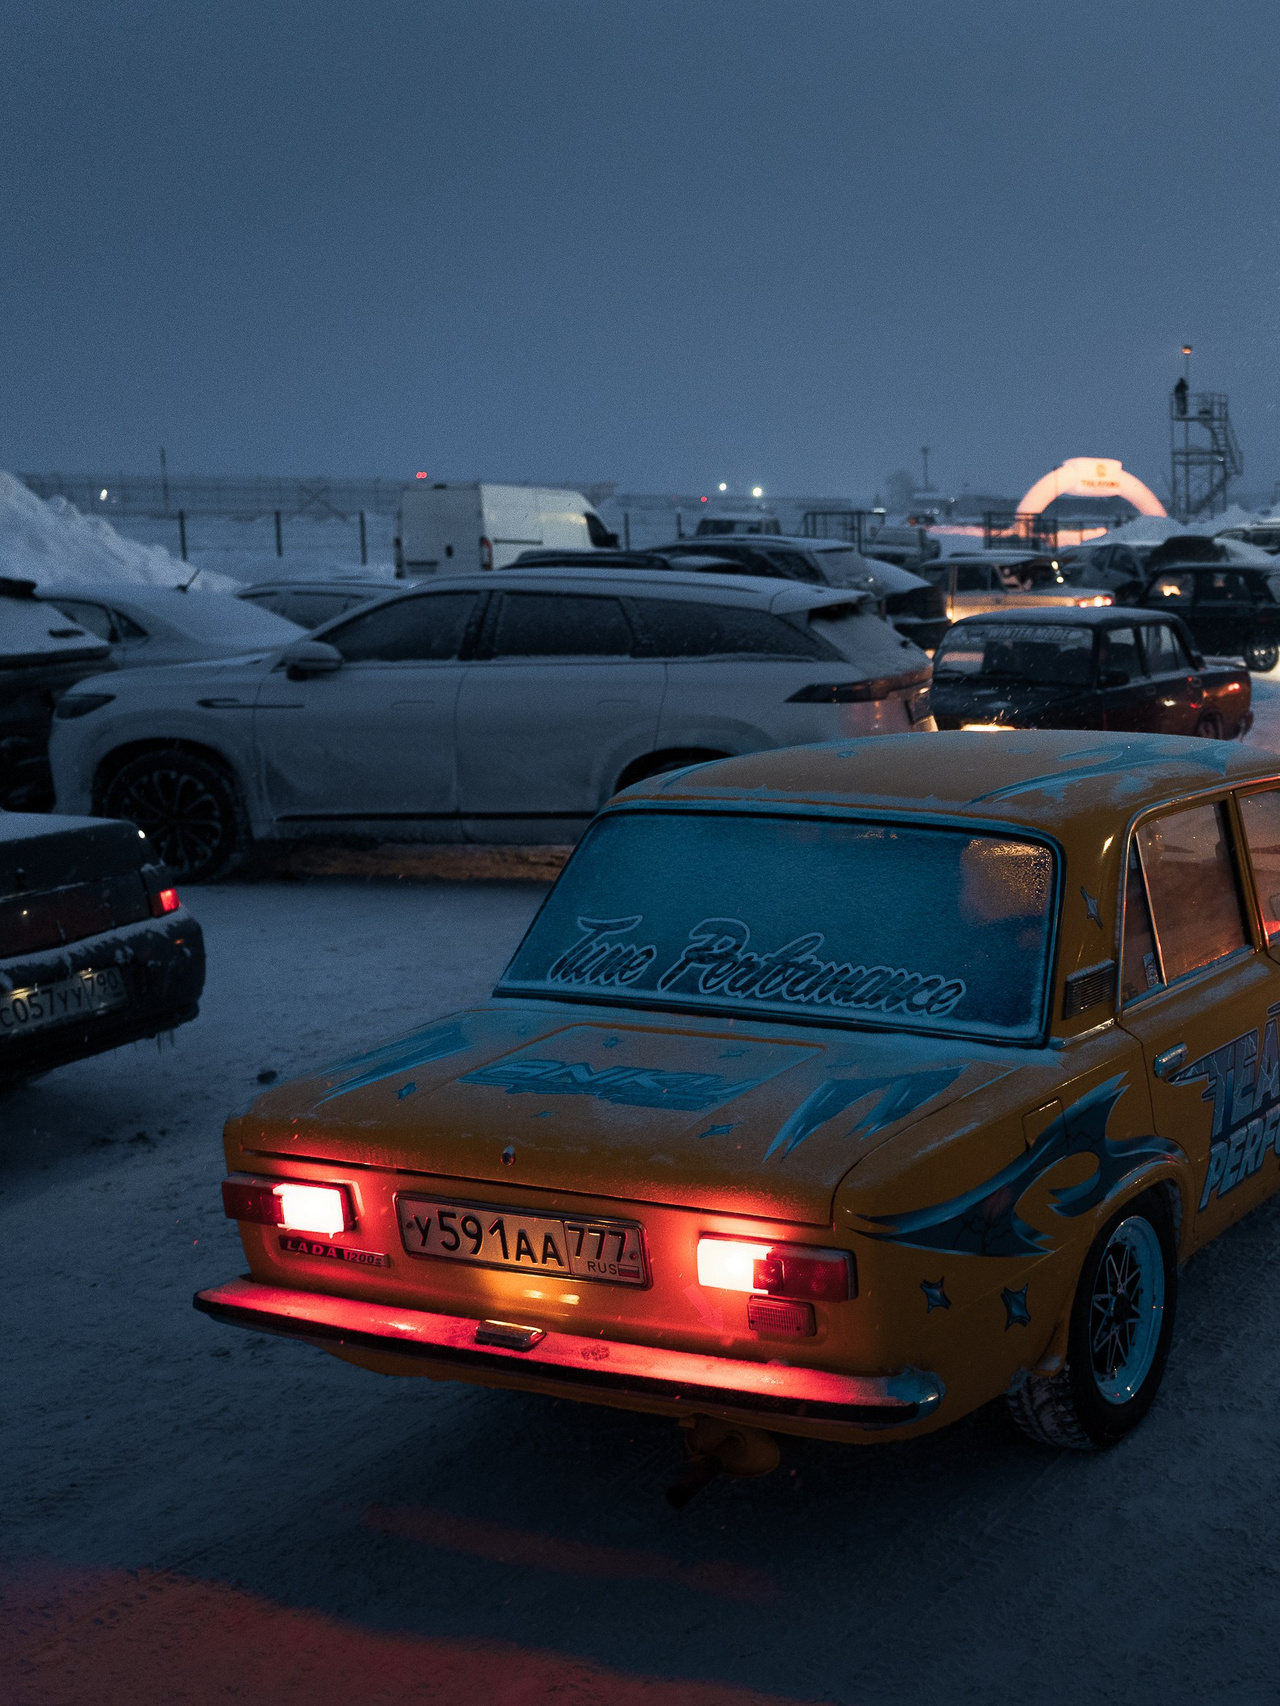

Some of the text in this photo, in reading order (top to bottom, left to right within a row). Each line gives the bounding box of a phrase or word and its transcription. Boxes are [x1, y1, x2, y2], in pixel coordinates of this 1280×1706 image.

[656, 917, 967, 1017] Performance
[84, 969, 119, 997] 790
[286, 1240, 338, 1258] LADA
[568, 1226, 628, 1263] 777
[587, 1260, 618, 1276] RUS
